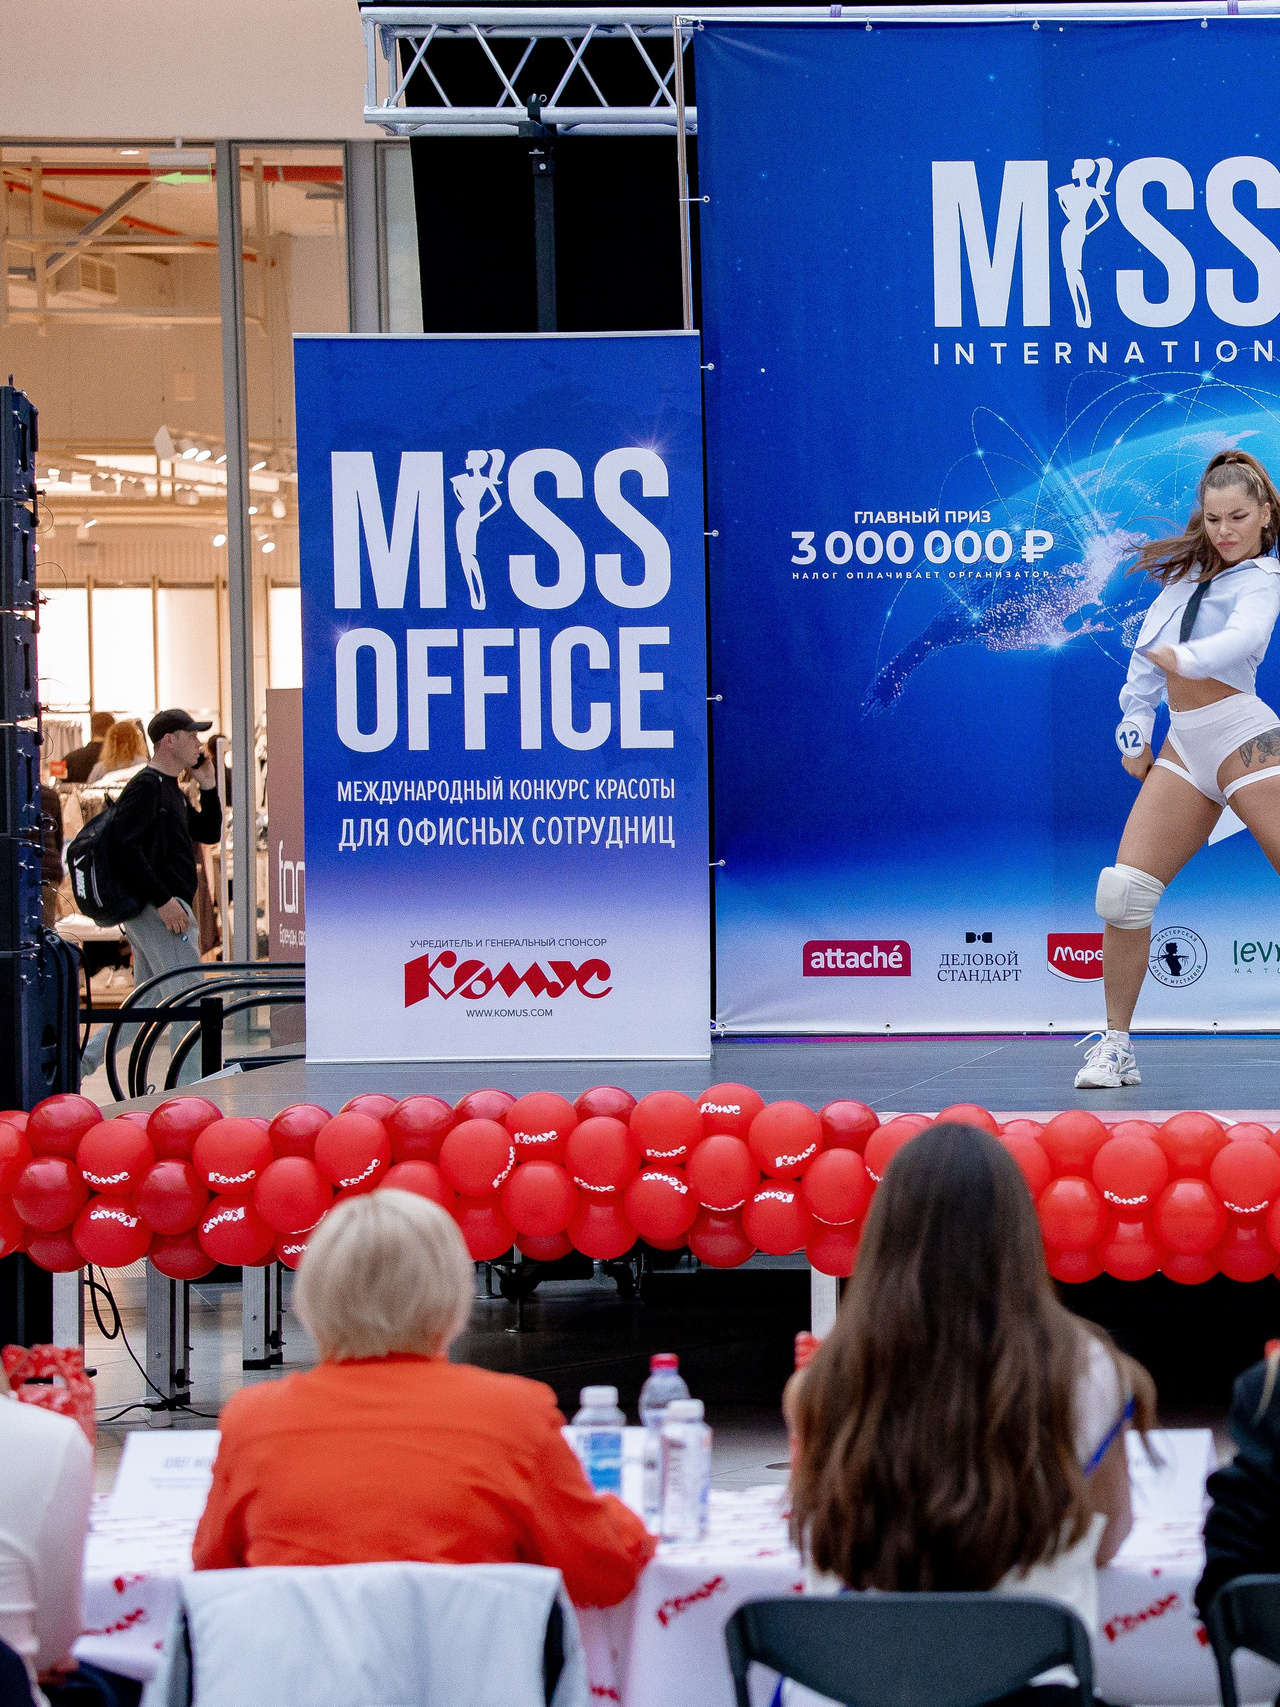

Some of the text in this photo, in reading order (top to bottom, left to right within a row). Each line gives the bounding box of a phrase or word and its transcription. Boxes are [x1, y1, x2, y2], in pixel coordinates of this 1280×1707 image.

[854, 508, 991, 524] ГЛАВНЫЙ ПРИЗ
[792, 570, 1050, 580] НАЛОГ ОПЛАЧИВАЕТ ОРГАНИЗАТОР
[335, 625, 674, 753] OFFICE
[1119, 730, 1141, 748] 12
[337, 776, 675, 804] МЕЖДУНАРОДНЫЙ КОНКУРС КРАСОТЫ
[338, 815, 675, 852] ДЛЯ ОФИСНЫХ СОТРУДНИЦ
[410, 937, 607, 948] УЧРЕДИТЕЛЬ И ГЕНЕРАЛЬНЫЙ СПОНСОР
[810, 945, 903, 969] attaché
[939, 950, 1019, 968] ДЕЛОВОЙ
[1053, 946, 1103, 964] Mape
[937, 969, 1022, 984] СТАНДАРТ
[466, 1009, 553, 1018] WWW.KOMUS.COM
